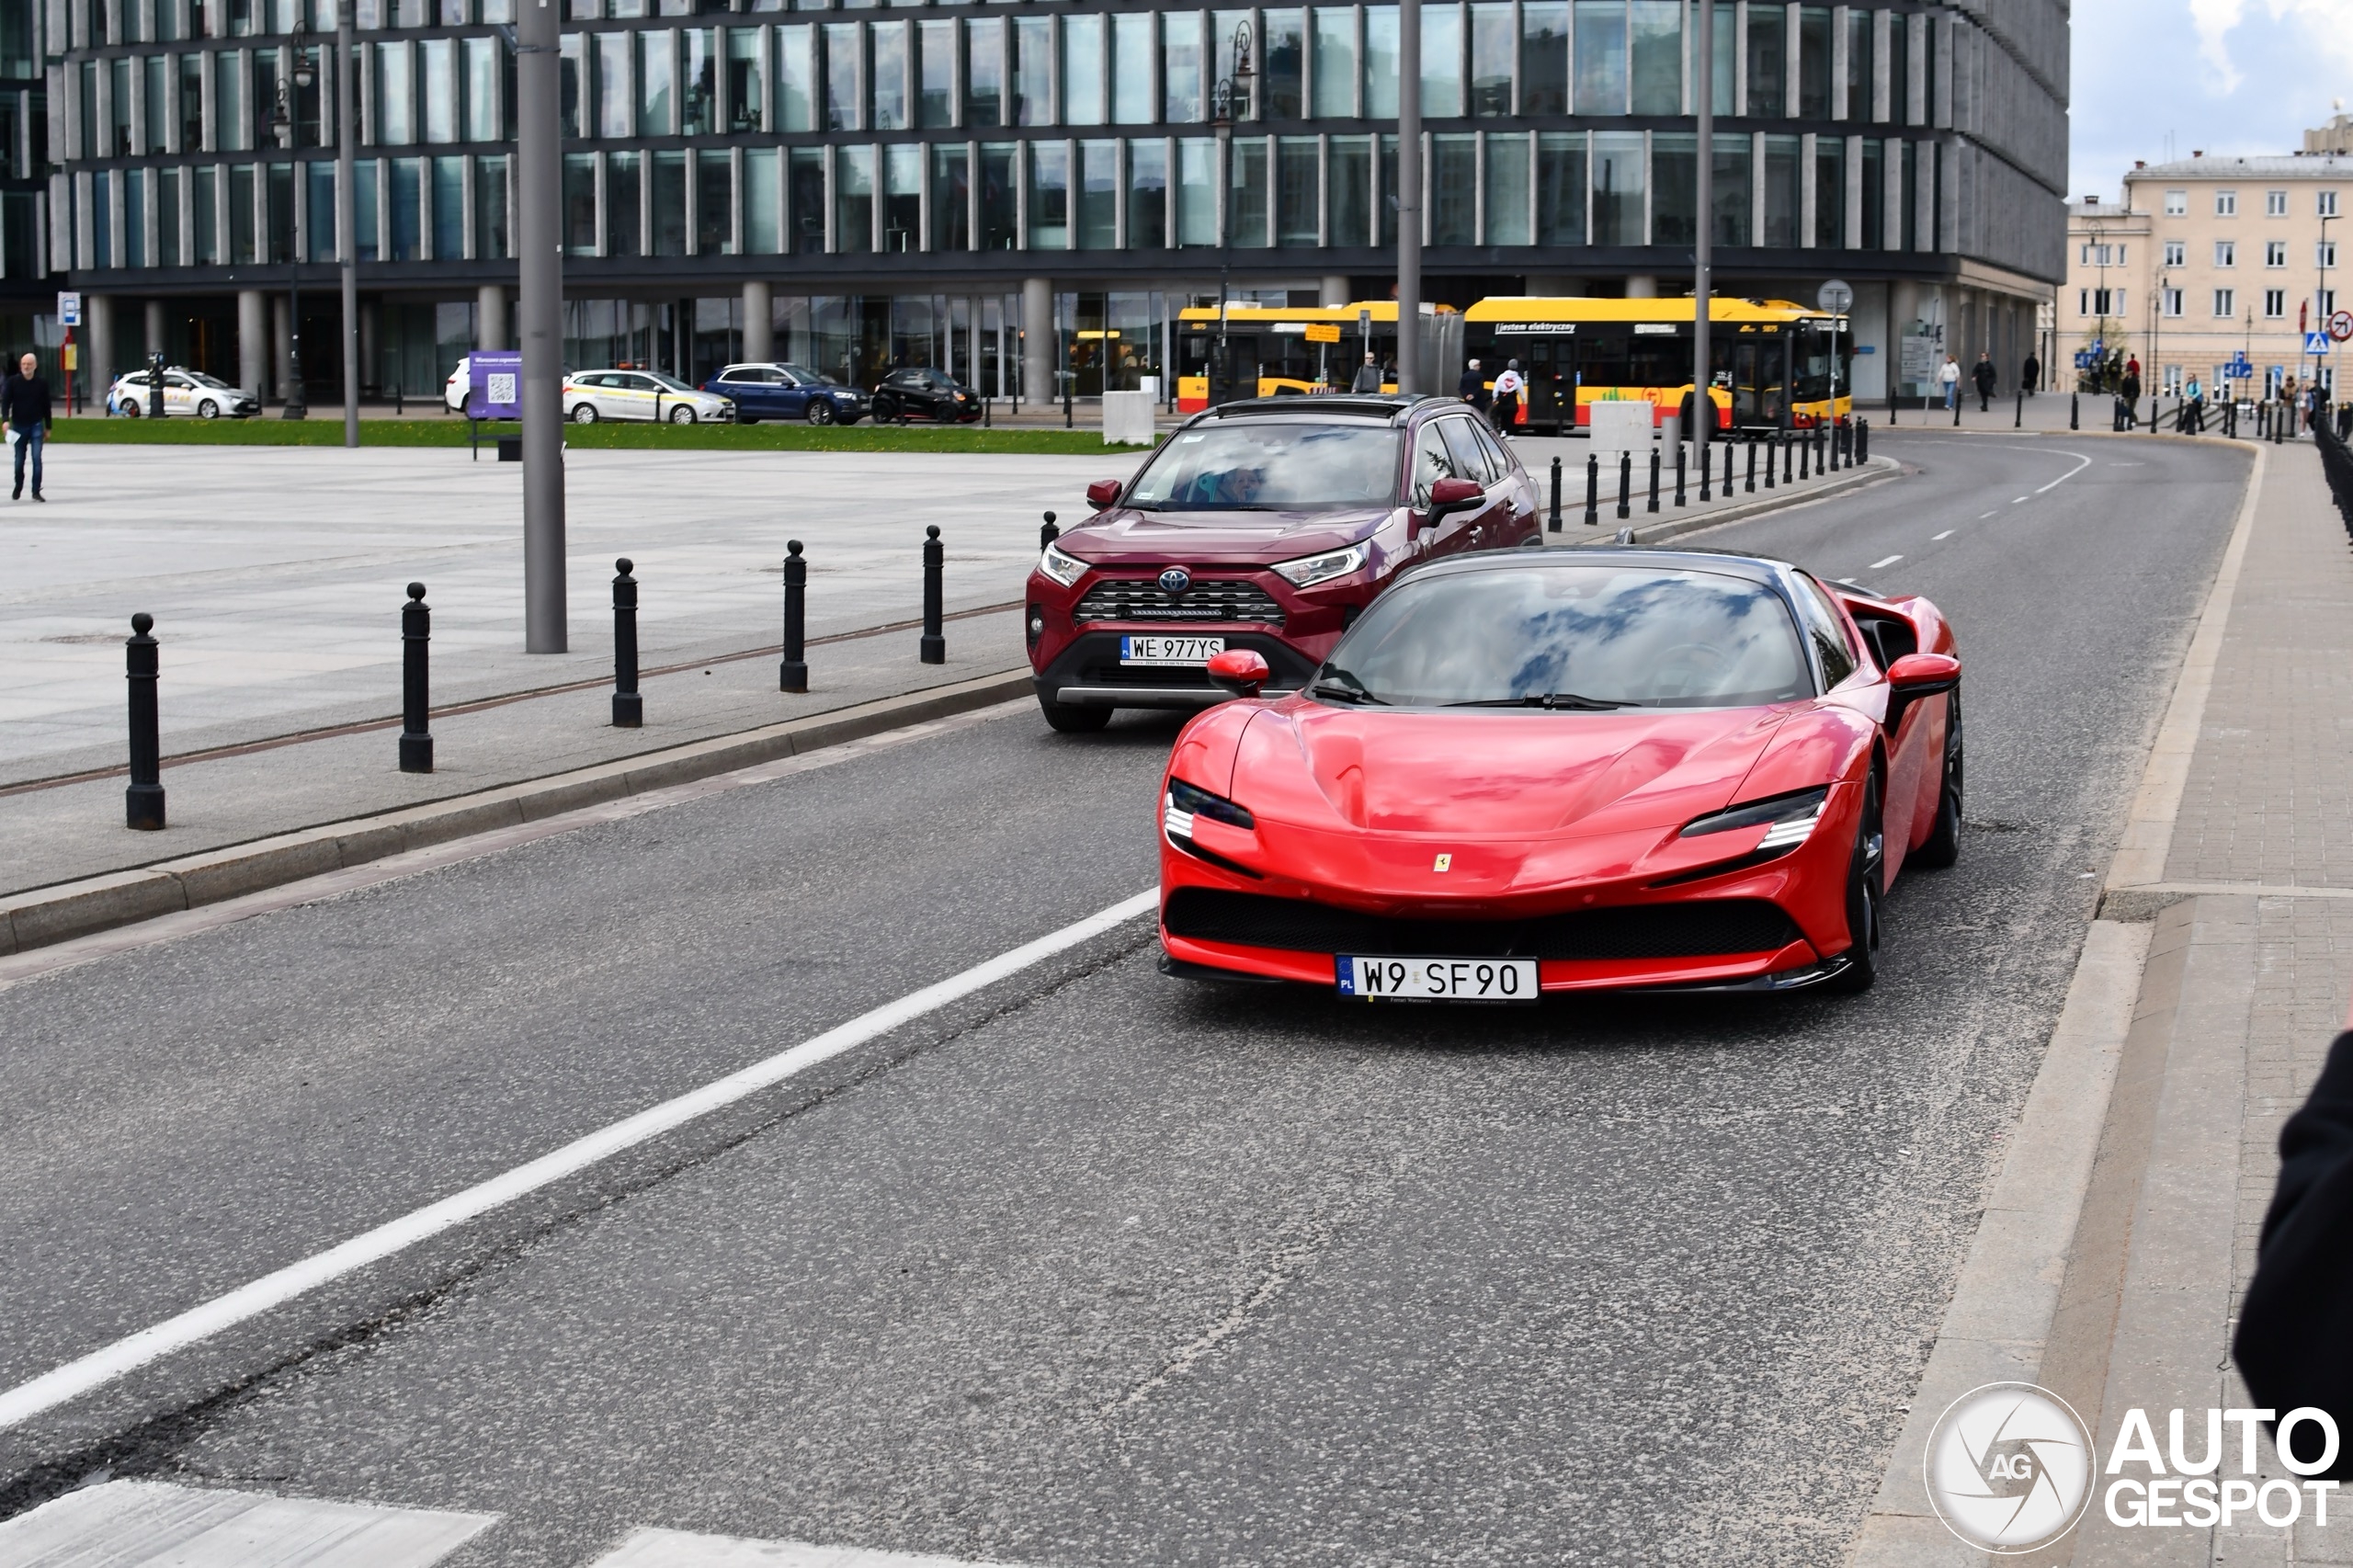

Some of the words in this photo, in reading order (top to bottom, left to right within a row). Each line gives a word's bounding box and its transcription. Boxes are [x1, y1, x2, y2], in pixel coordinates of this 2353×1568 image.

[1499, 323, 1527, 332] jestem
[1528, 323, 1576, 333] elektryczny
[1134, 640, 1157, 657] WE
[1165, 640, 1220, 658] 977YS
[1341, 981, 1353, 989] PL
[1363, 961, 1406, 993] W9
[1426, 962, 1518, 995] SF90
